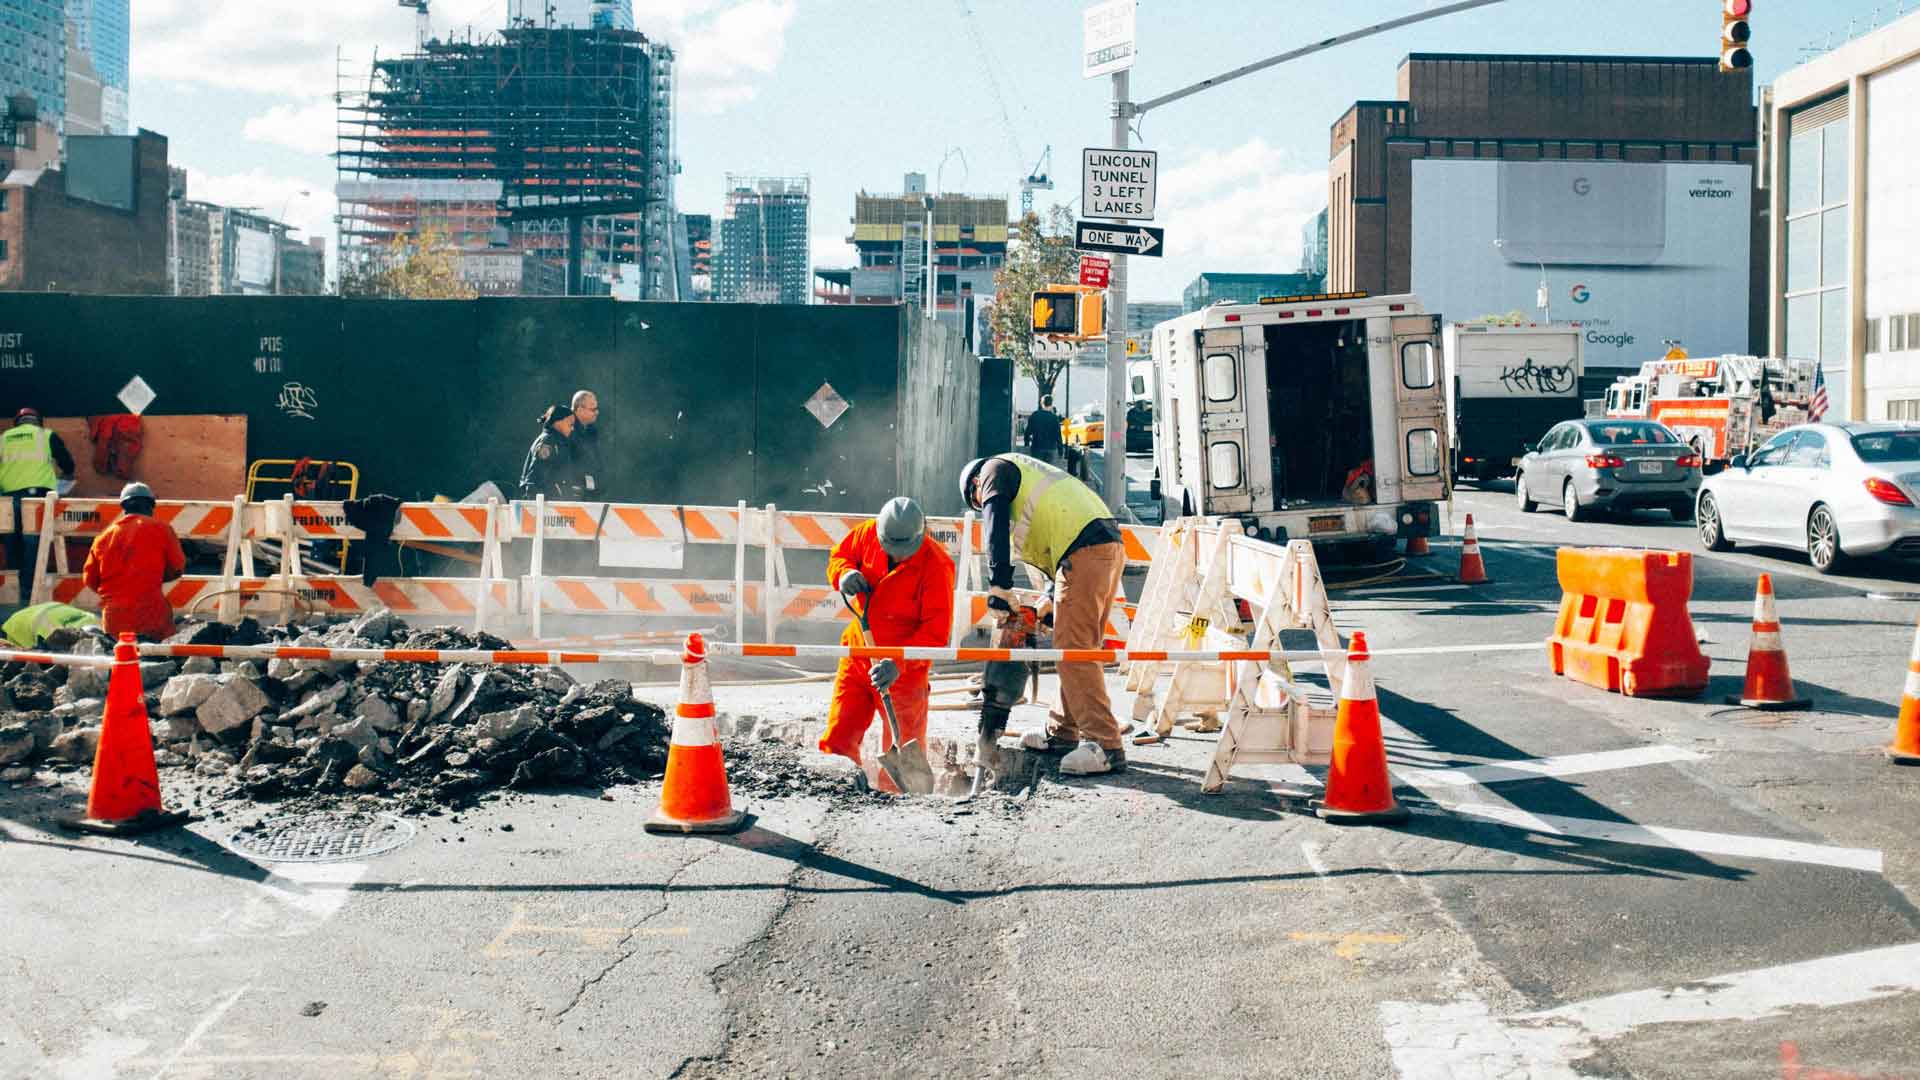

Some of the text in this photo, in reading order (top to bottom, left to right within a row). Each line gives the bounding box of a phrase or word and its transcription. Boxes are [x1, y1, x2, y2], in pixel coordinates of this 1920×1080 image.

[1089, 154, 1151, 168] LINCOLN
[1091, 170, 1148, 183] TUNNEL
[1093, 185, 1145, 198] 3 LEFT
[1573, 177, 1591, 196] G
[1689, 187, 1732, 199] verizon
[1094, 201, 1143, 214] LANES
[1088, 231, 1150, 247] ONE WAY
[1572, 284, 1590, 304] G
[0, 333, 23, 348] OST
[1586, 330, 1635, 348] Google
